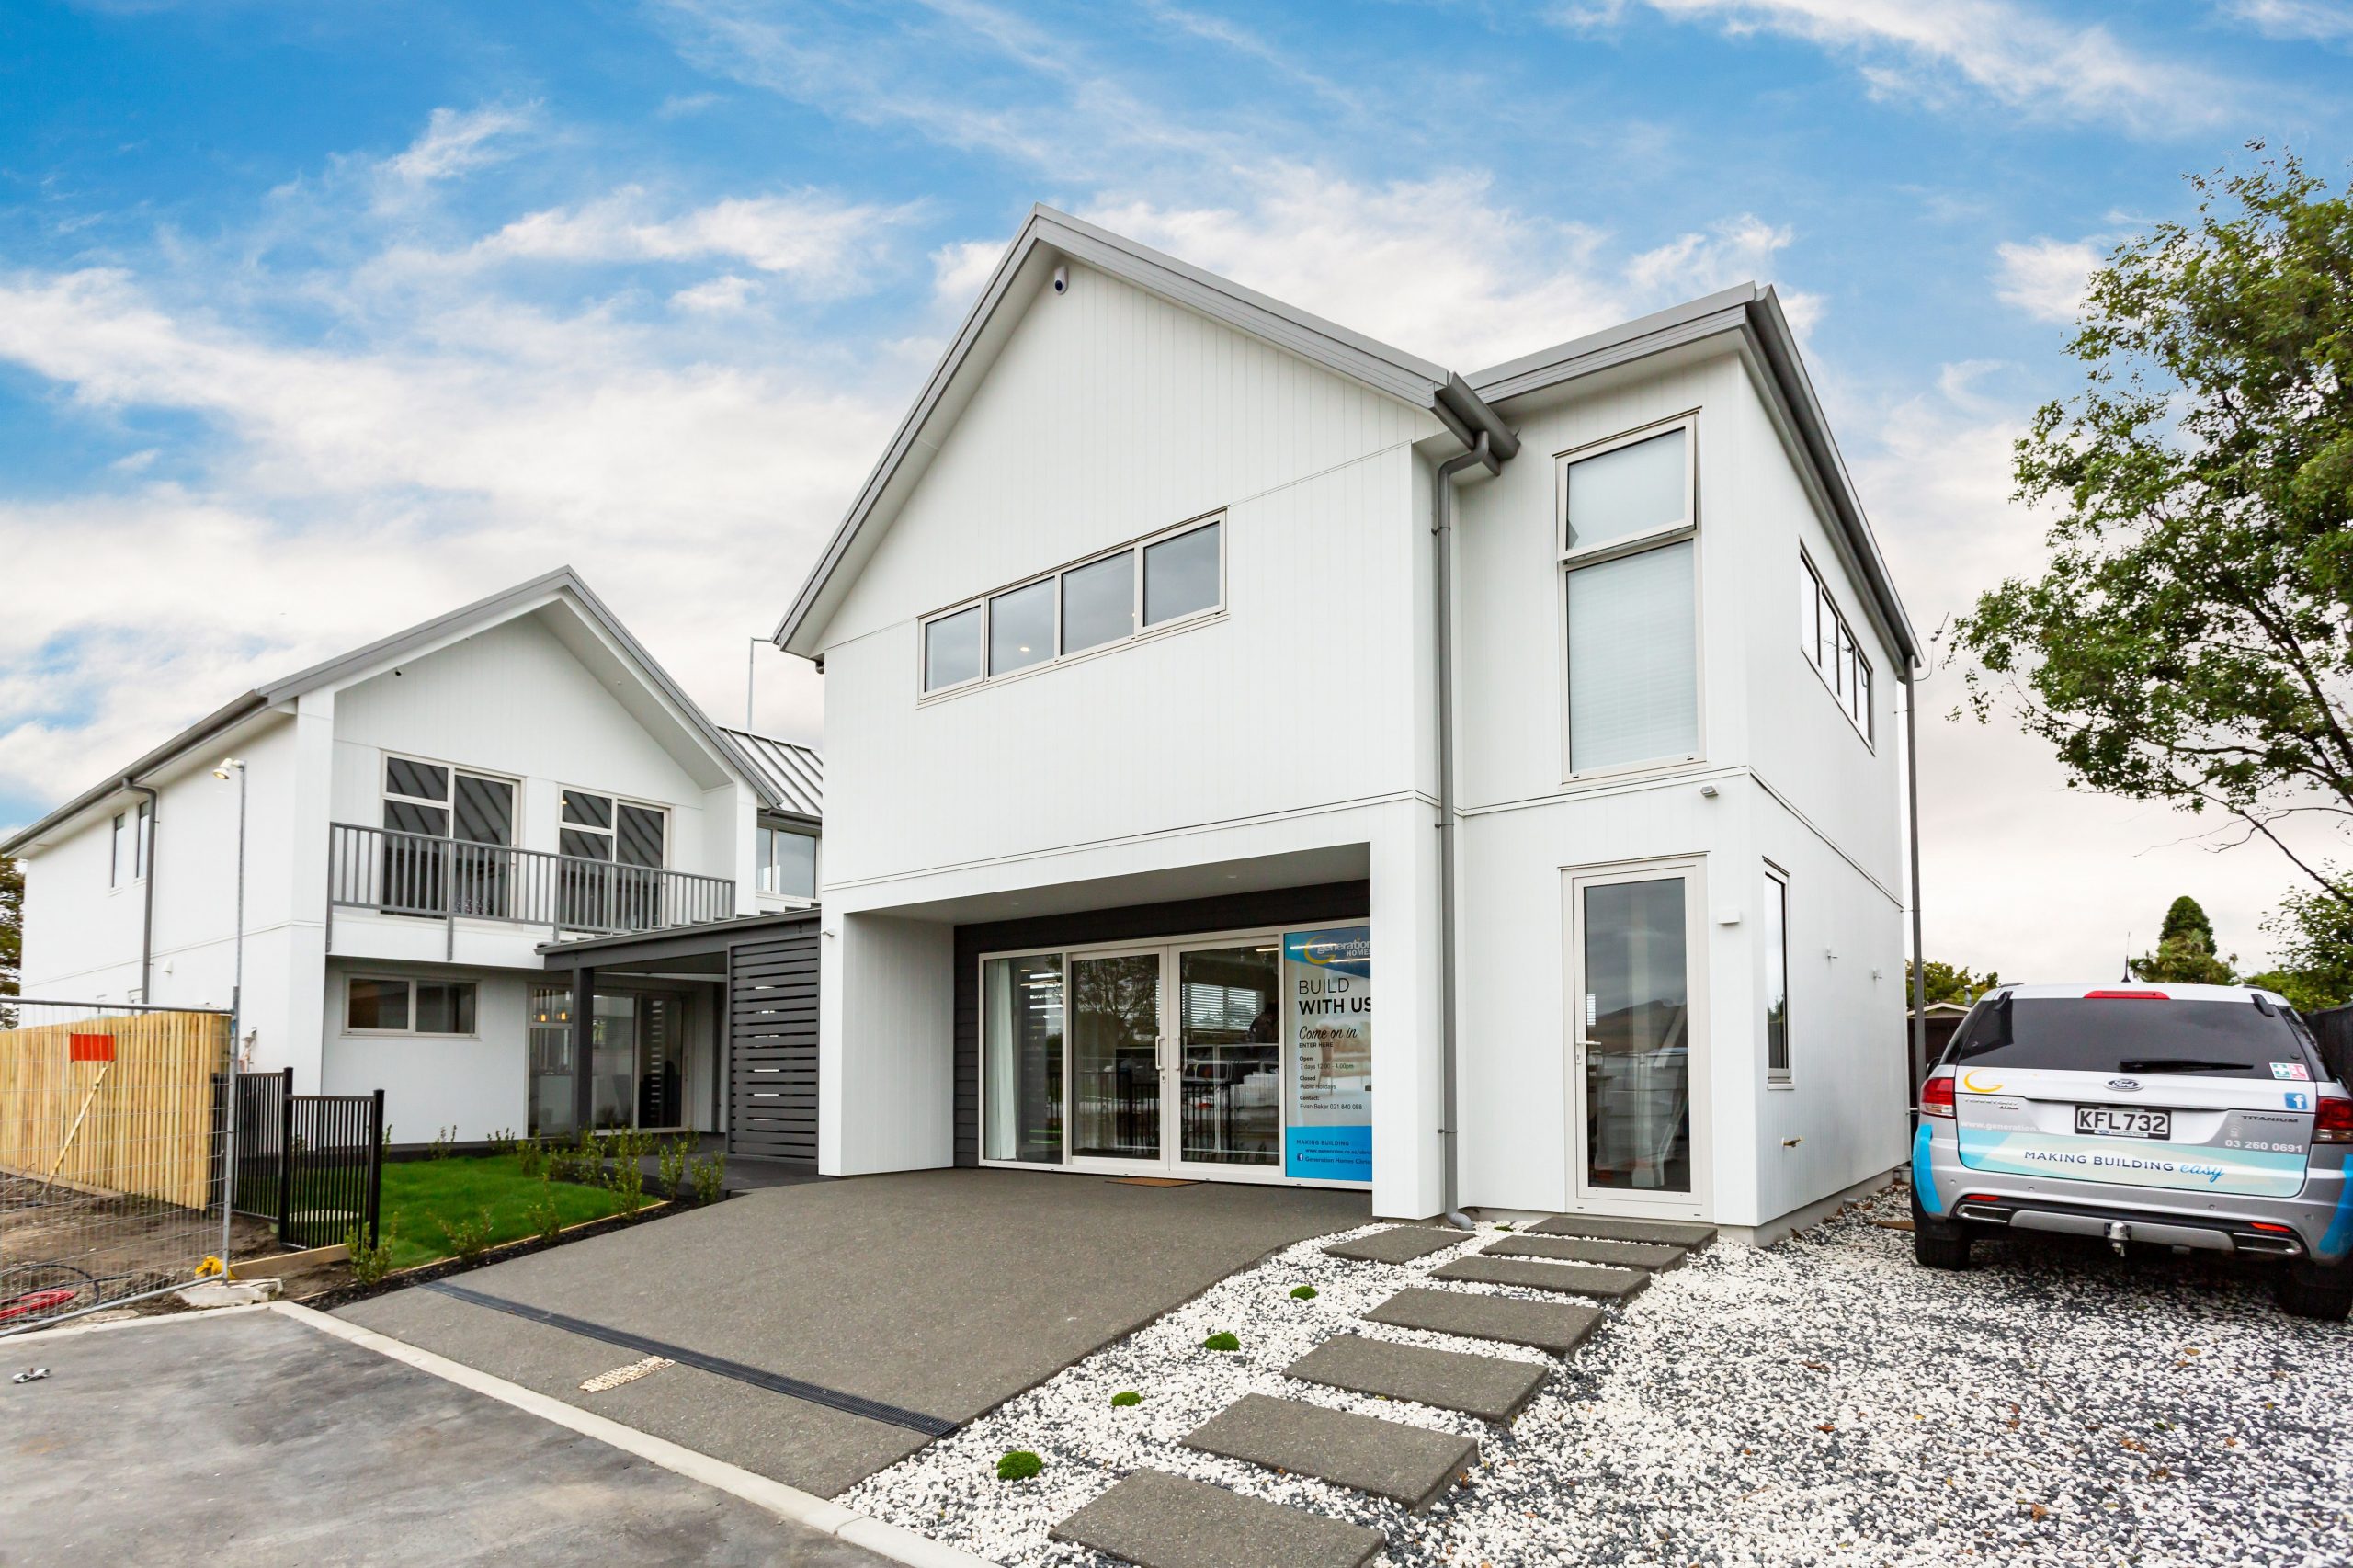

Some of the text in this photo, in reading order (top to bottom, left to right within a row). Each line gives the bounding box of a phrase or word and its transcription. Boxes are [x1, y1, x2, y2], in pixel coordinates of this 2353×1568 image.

[1299, 977, 1350, 994] BUILD
[1299, 997, 1370, 1015] WITH US
[1299, 1026, 1358, 1040] Come on in
[2079, 1110, 2166, 1132] KFL732
[2225, 1139, 2302, 1153] 03 260 0691
[2024, 1151, 2225, 1183] MAKING BUILDING easy
